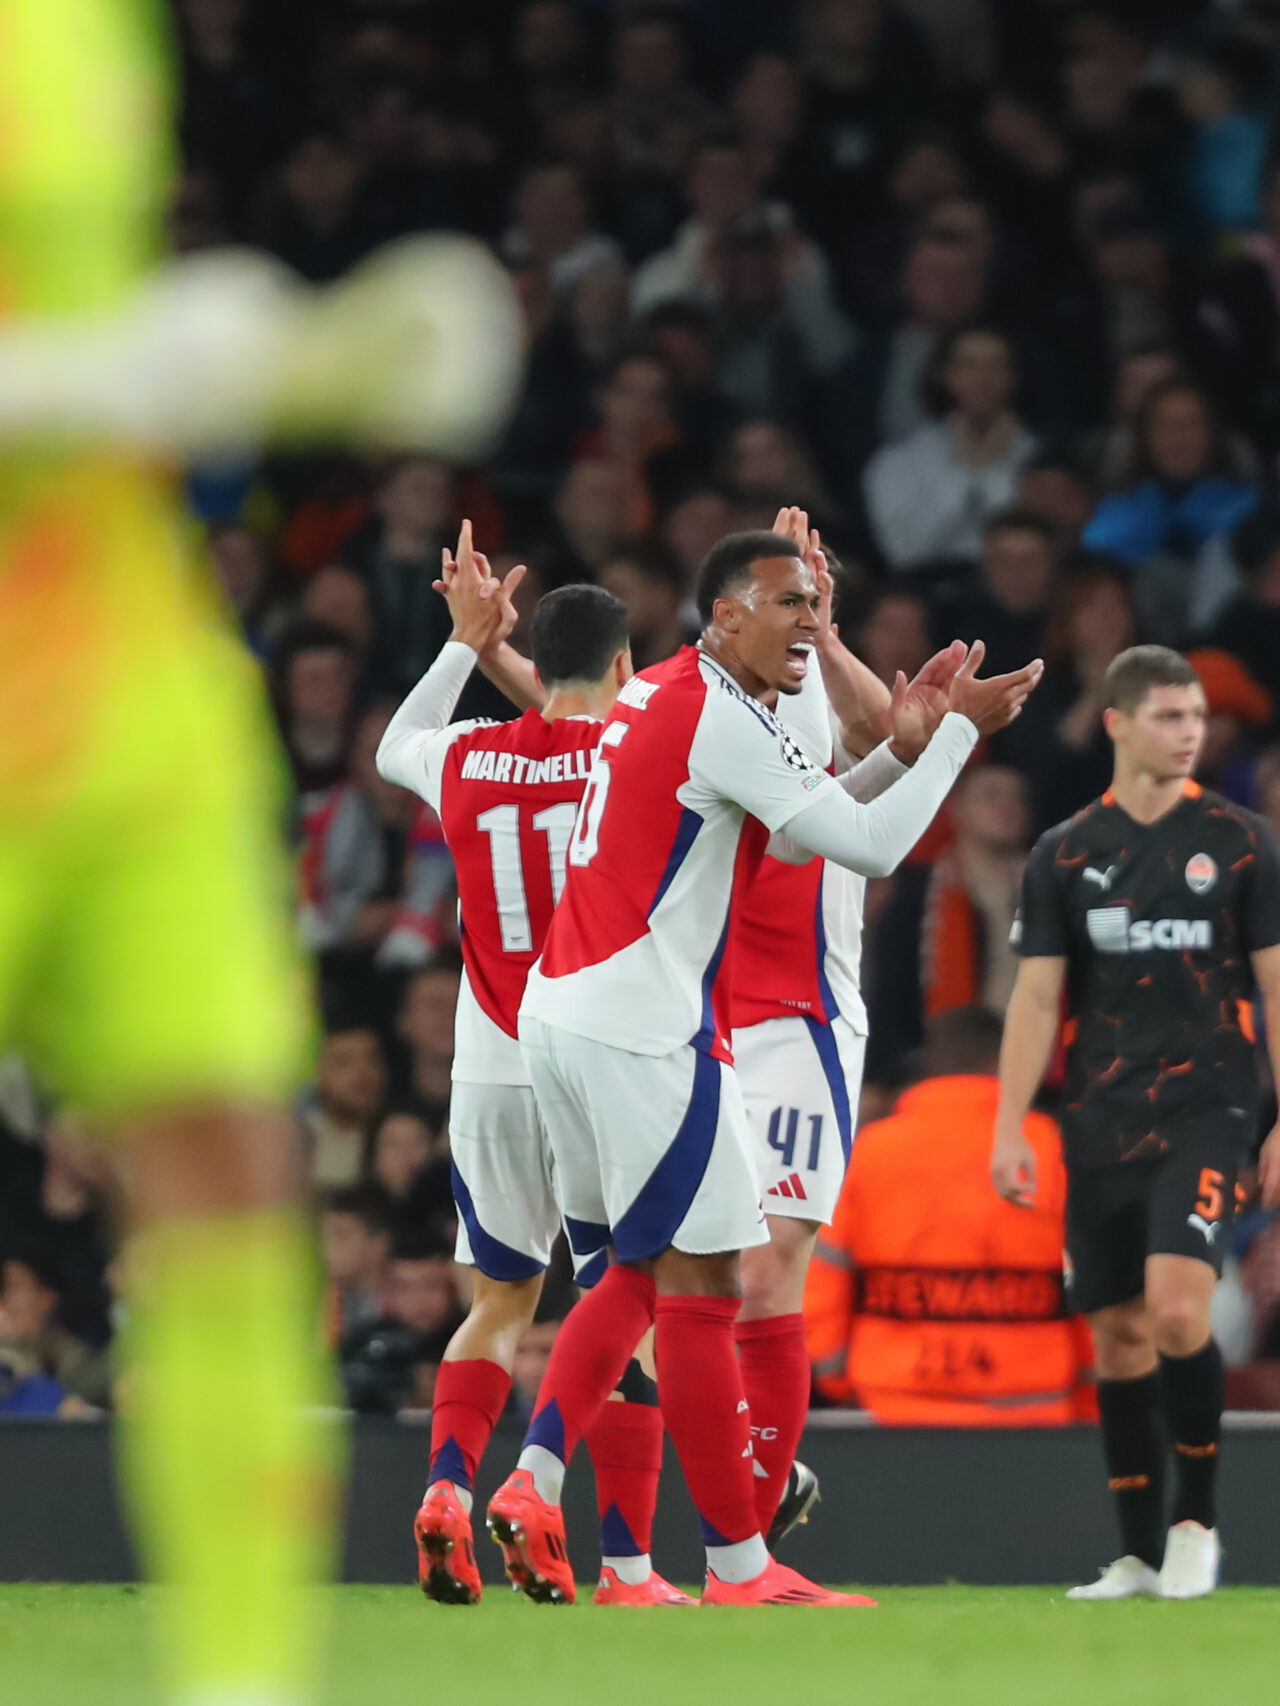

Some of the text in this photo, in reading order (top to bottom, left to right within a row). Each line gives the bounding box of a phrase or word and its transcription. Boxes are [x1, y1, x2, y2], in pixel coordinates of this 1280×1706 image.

[476, 802, 579, 952] 11
[1128, 918, 1213, 950] SCM
[767, 1105, 823, 1172] 41
[1194, 1166, 1225, 1221] 5
